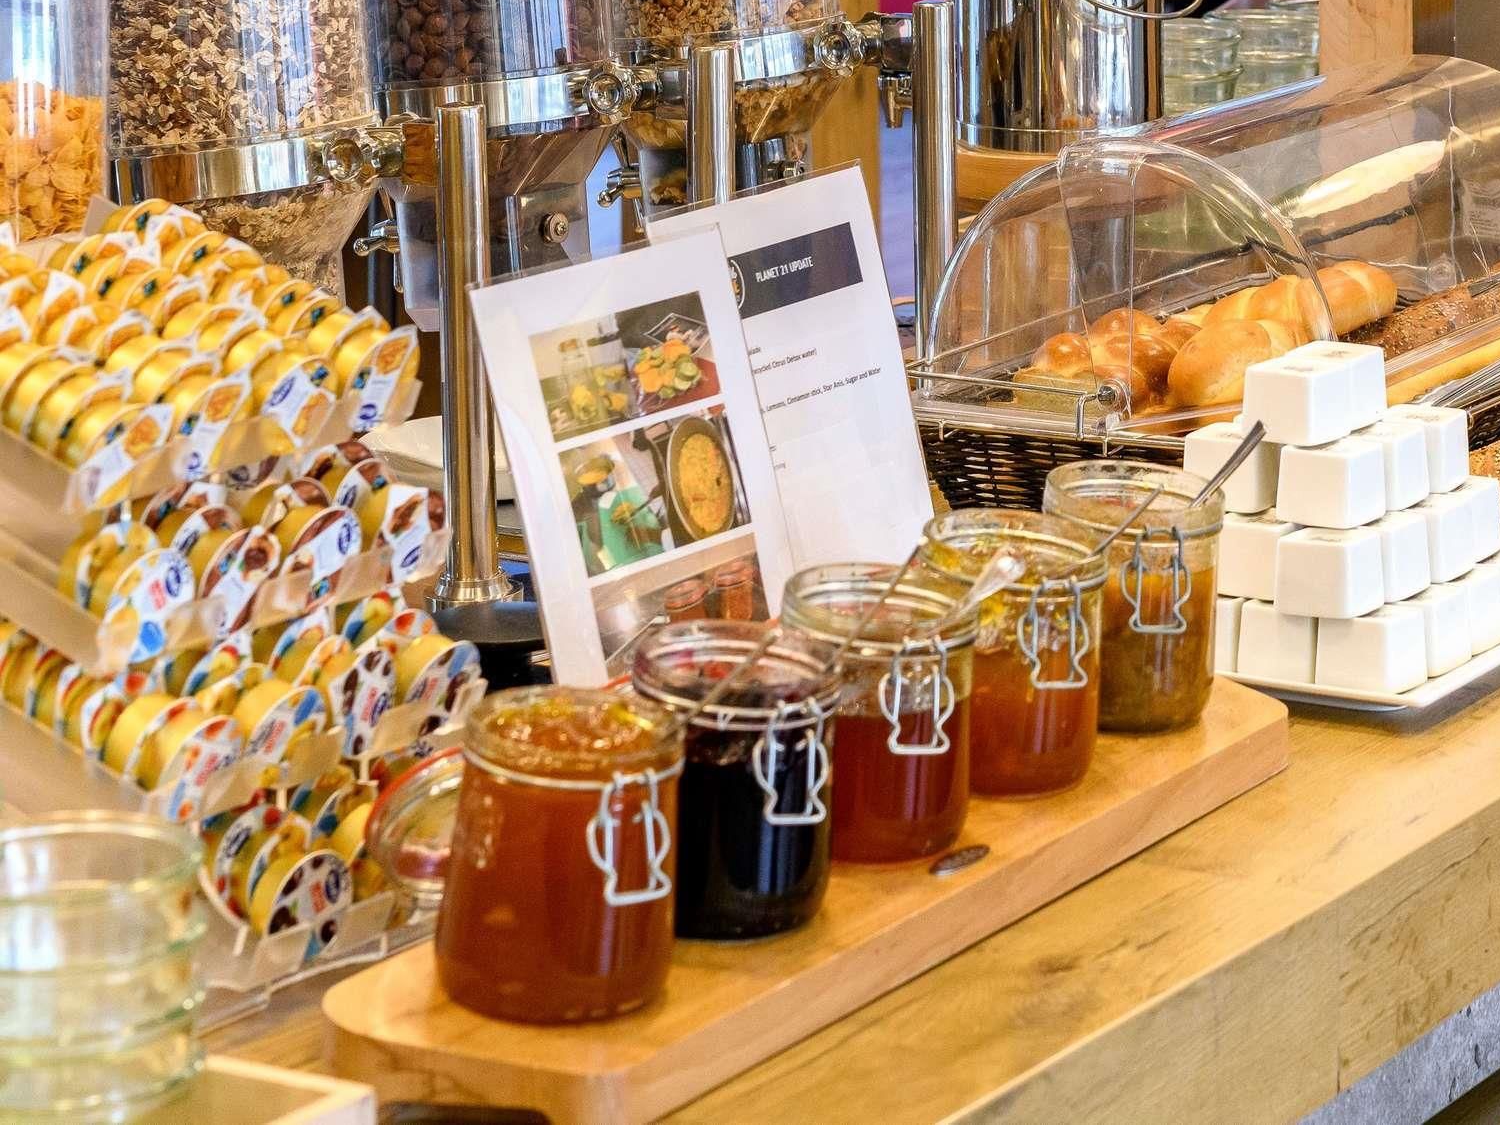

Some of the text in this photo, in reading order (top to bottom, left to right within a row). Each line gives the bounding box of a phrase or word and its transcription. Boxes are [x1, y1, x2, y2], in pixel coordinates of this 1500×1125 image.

[755, 256, 814, 282] PLANET 21 UPDATE
